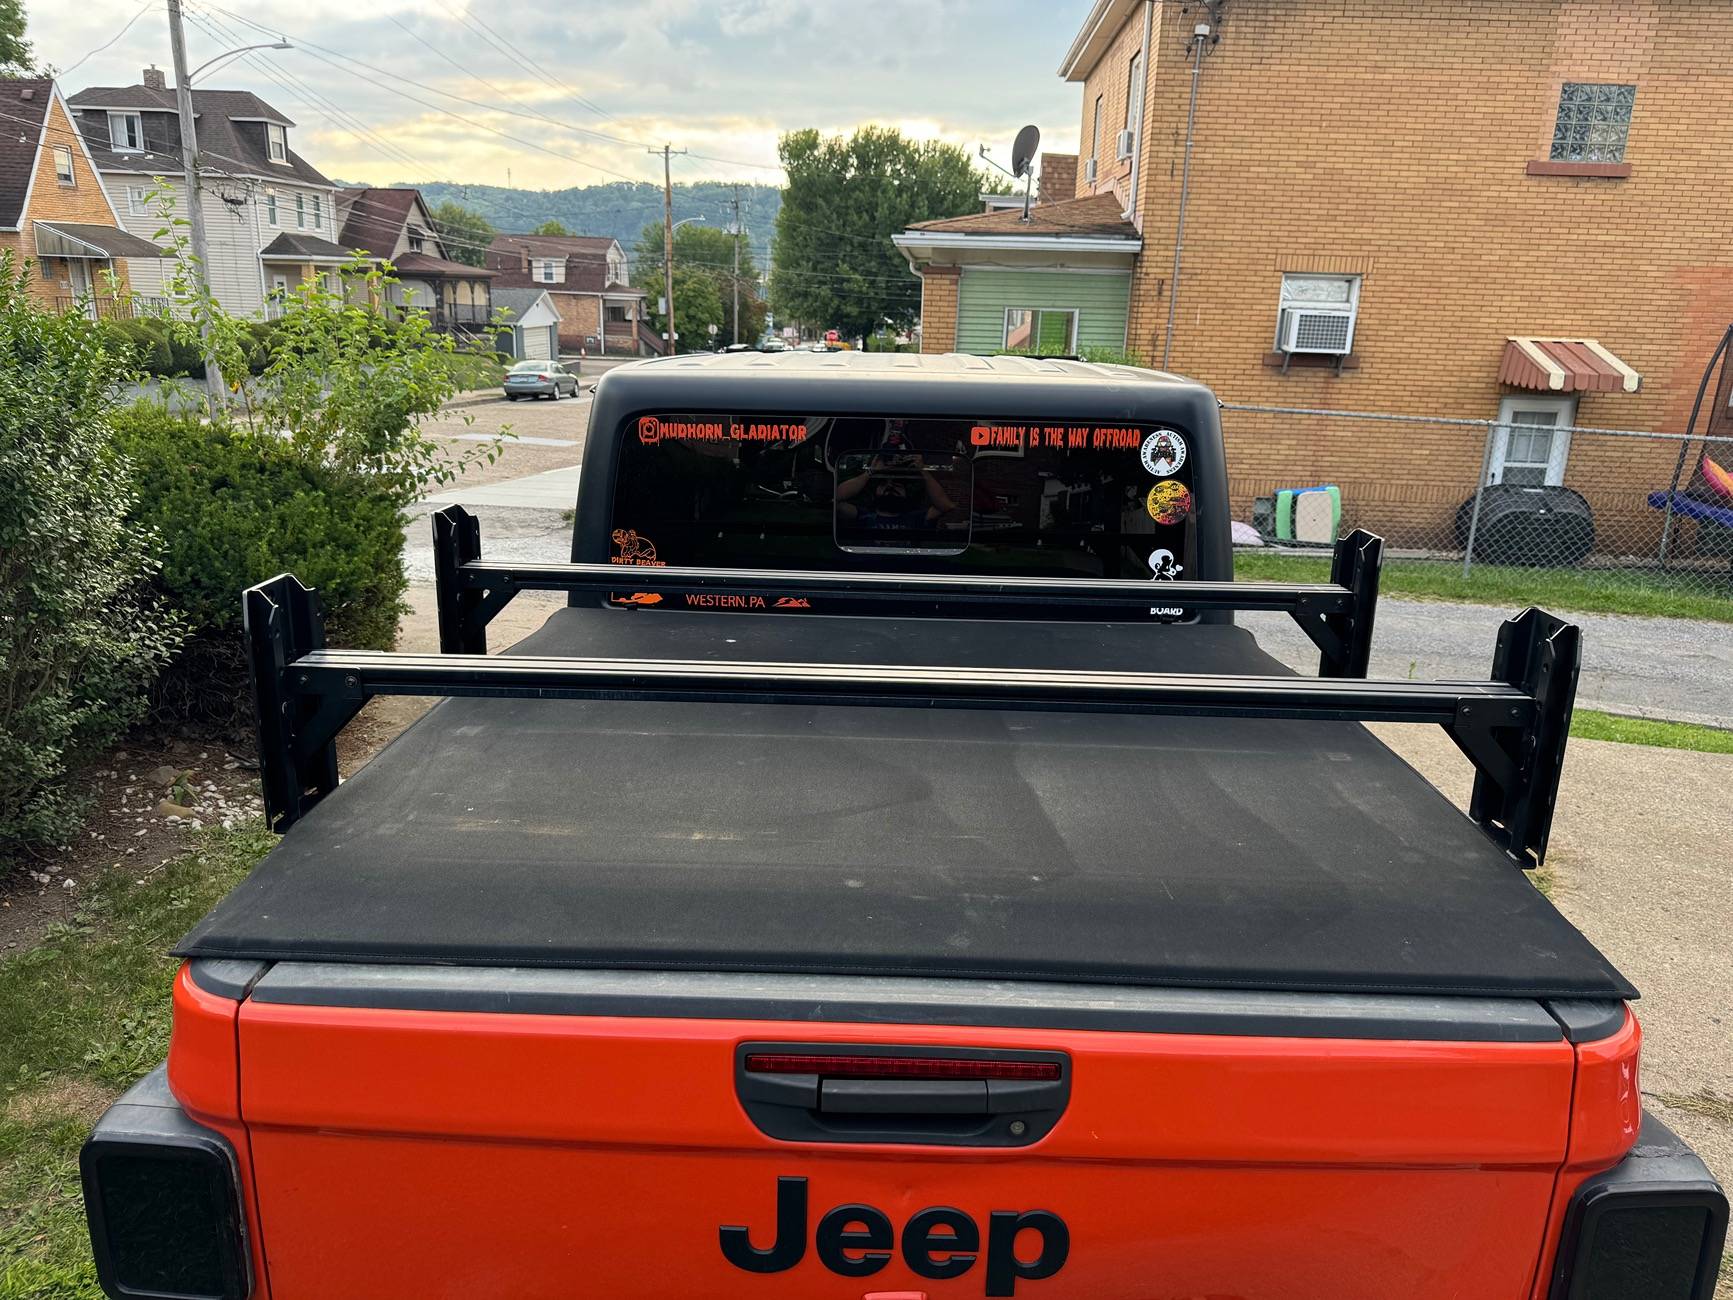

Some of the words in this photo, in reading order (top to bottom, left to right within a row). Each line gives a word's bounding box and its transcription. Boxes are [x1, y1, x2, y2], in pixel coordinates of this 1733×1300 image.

[991, 427, 1025, 447] FAMILY
[1029, 427, 1040, 448] IS
[1044, 427, 1064, 450] THE
[1068, 427, 1089, 449] WAY
[1093, 428, 1141, 450] OFFROAD
[611, 556, 634, 565] DIRTY
[749, 596, 766, 608] PA
[1150, 607, 1184, 616] BOARD
[719, 1176, 1070, 1297] Jeep
